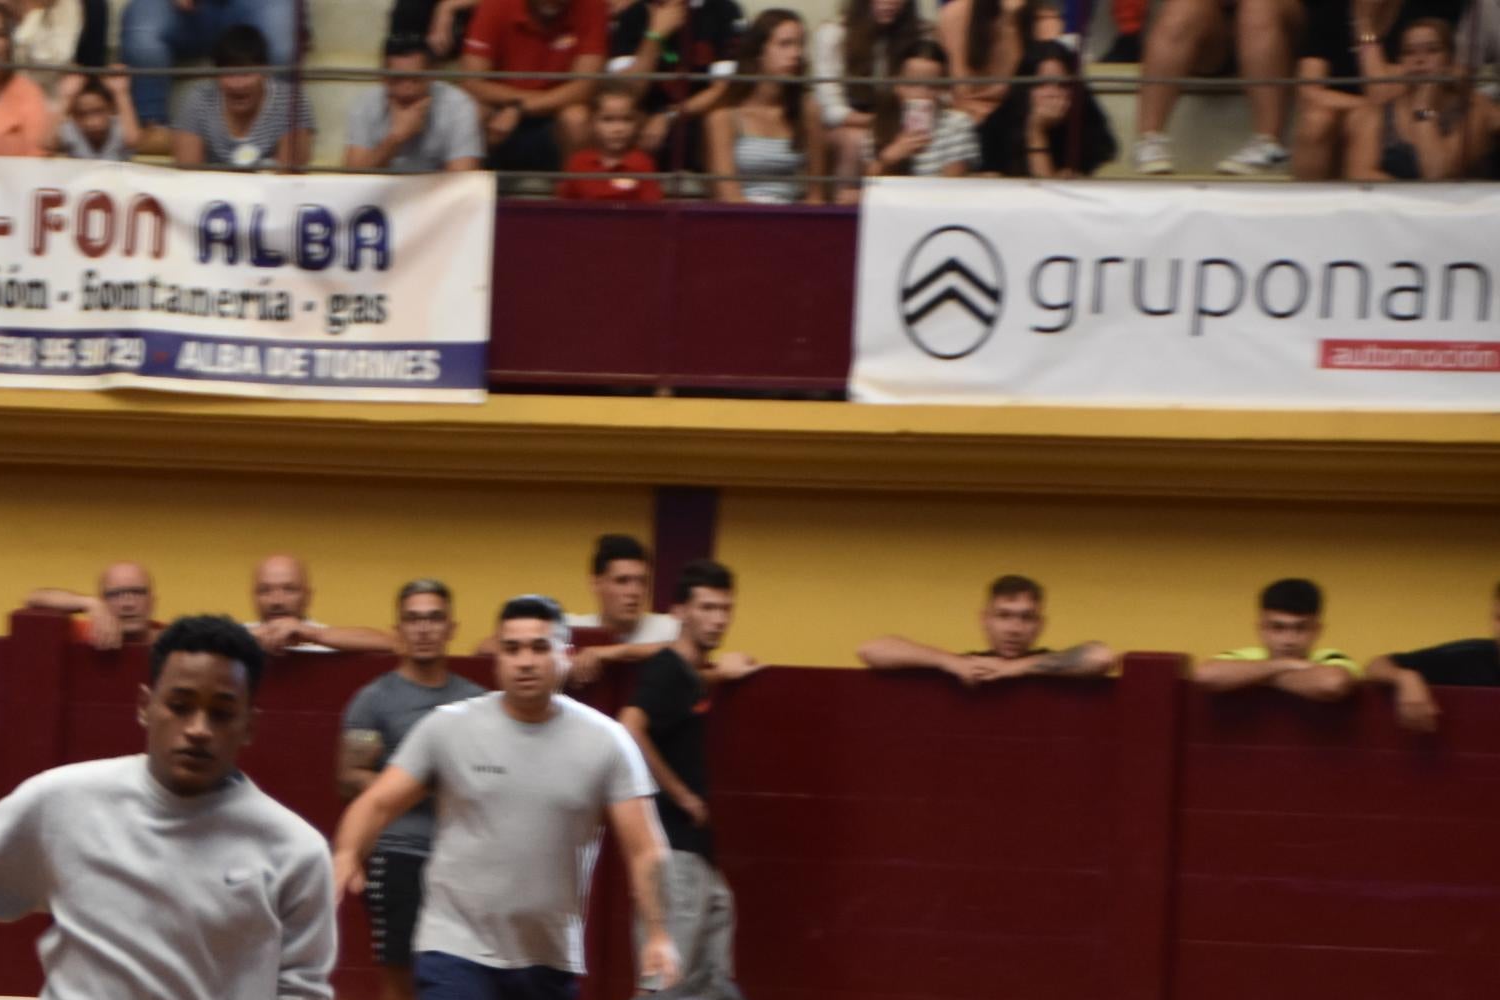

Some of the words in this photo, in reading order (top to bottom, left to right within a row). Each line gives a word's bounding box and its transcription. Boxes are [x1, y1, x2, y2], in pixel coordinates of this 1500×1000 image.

[28, 186, 169, 260] FON
[195, 198, 393, 272] ALBA
[79, 268, 293, 322] fontanería
[325, 291, 389, 335] gas
[1029, 253, 1492, 337] gruponan
[174, 340, 262, 374] ALBA
[265, 345, 312, 378] DE
[314, 348, 441, 380] TORMES
